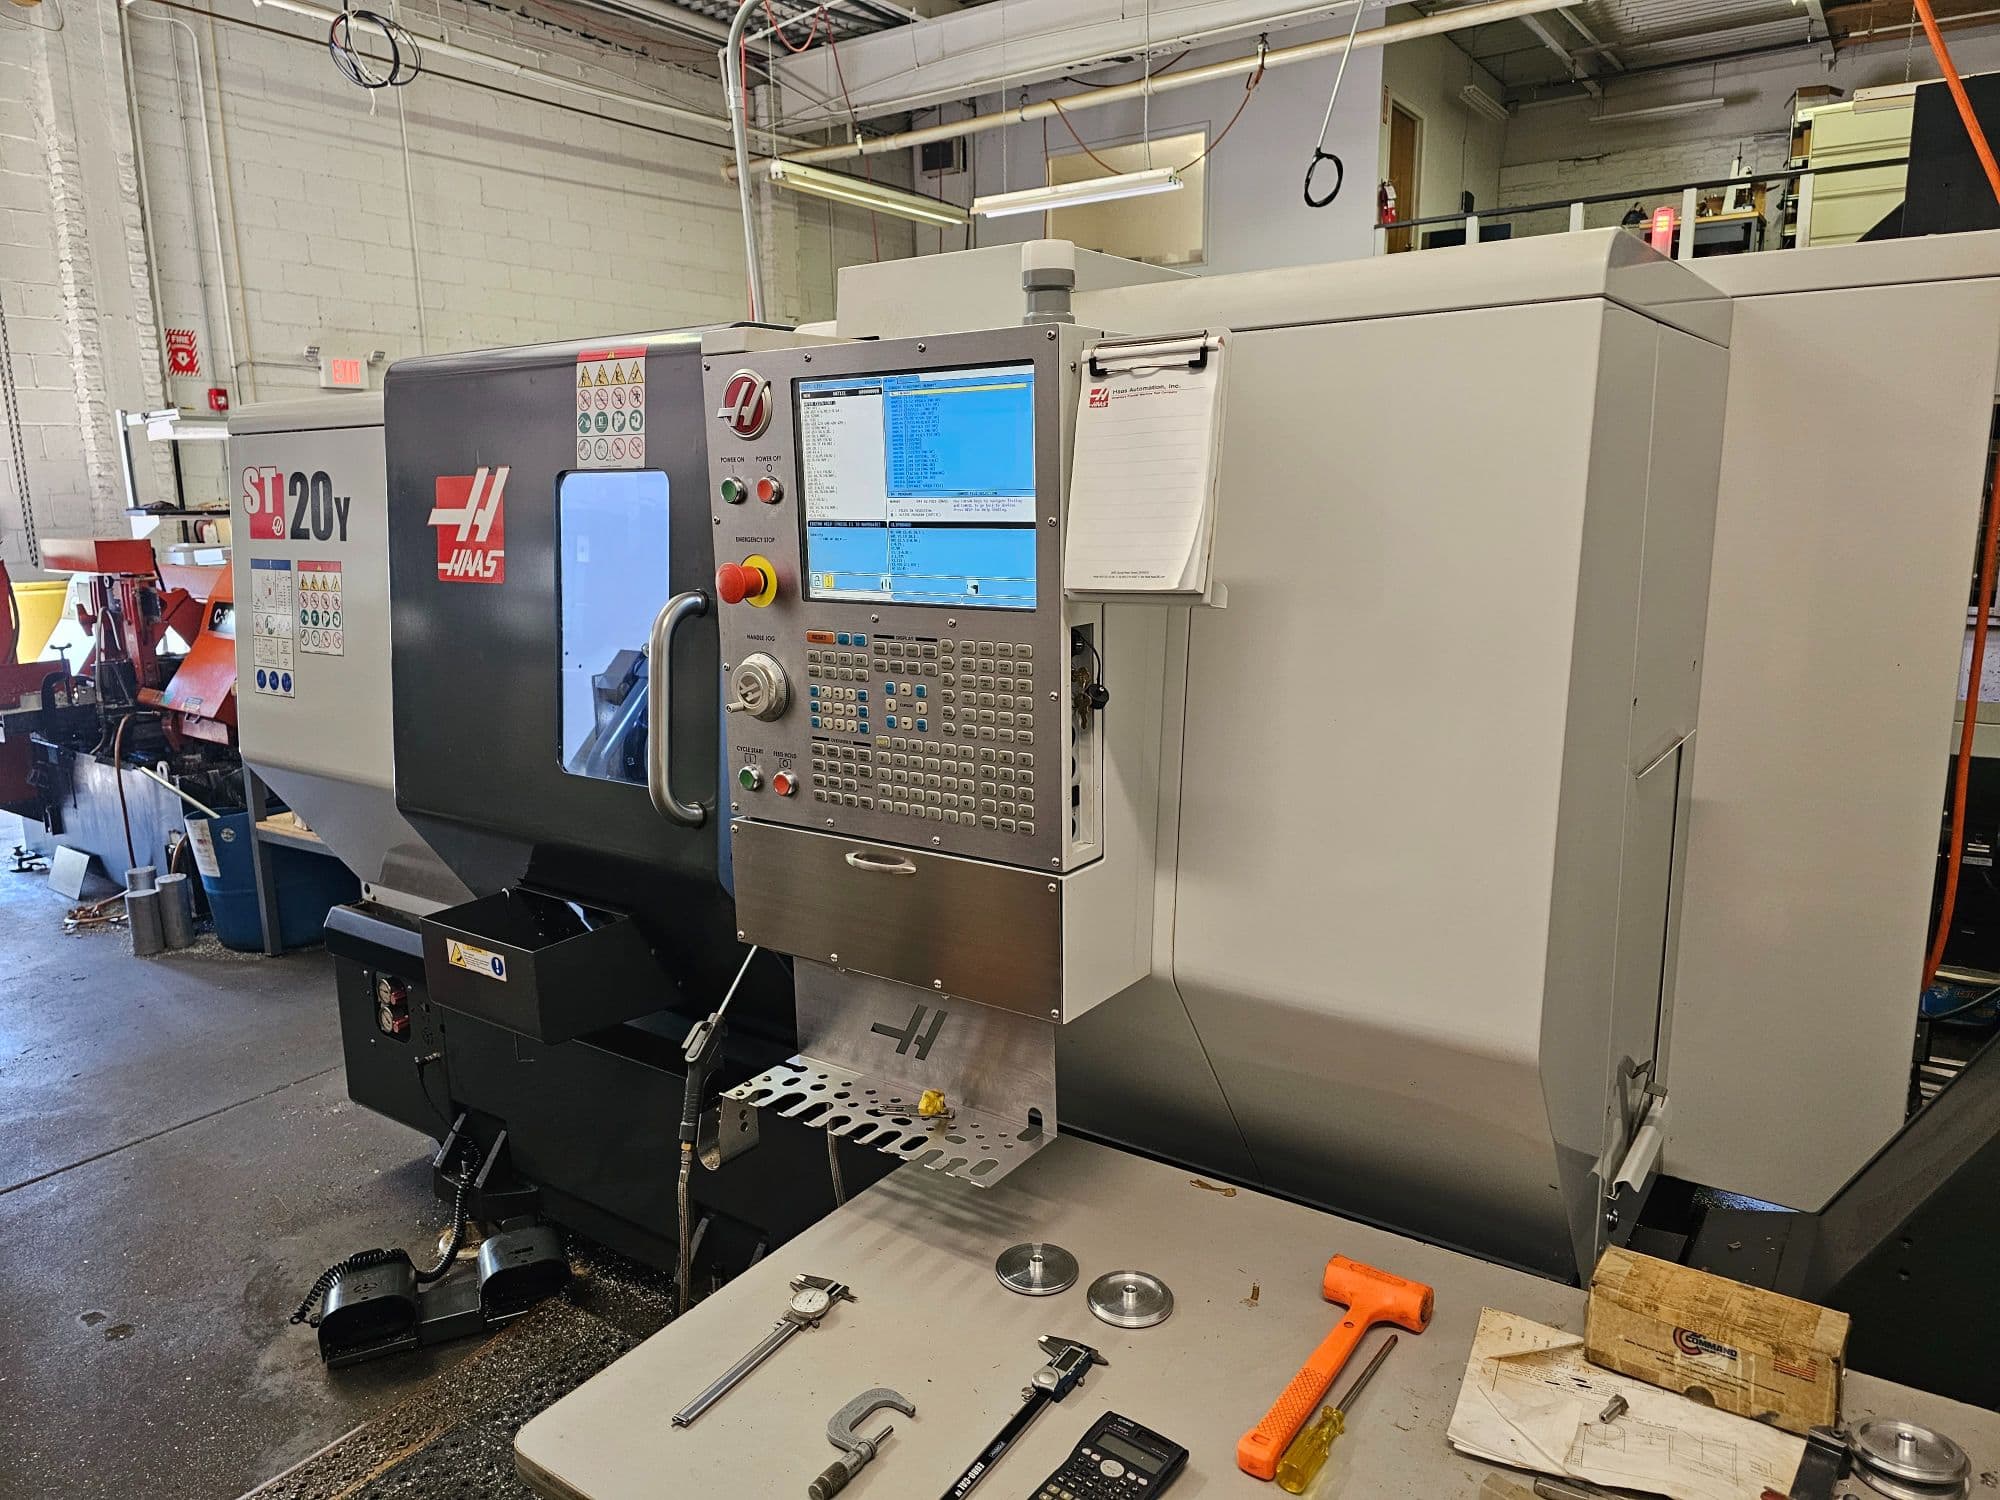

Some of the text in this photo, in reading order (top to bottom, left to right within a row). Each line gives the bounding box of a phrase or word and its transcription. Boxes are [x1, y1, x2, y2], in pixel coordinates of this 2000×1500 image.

[171, 335, 190, 344] FIRE
[332, 359, 360, 384] EXIT
[1129, 384, 1166, 393] Automation,
[242, 466, 278, 515] ST
[437, 548, 505, 579] HAAS
[1686, 1335, 1738, 1357] COMMAND
[957, 1462, 985, 1490] EURO-CAL
